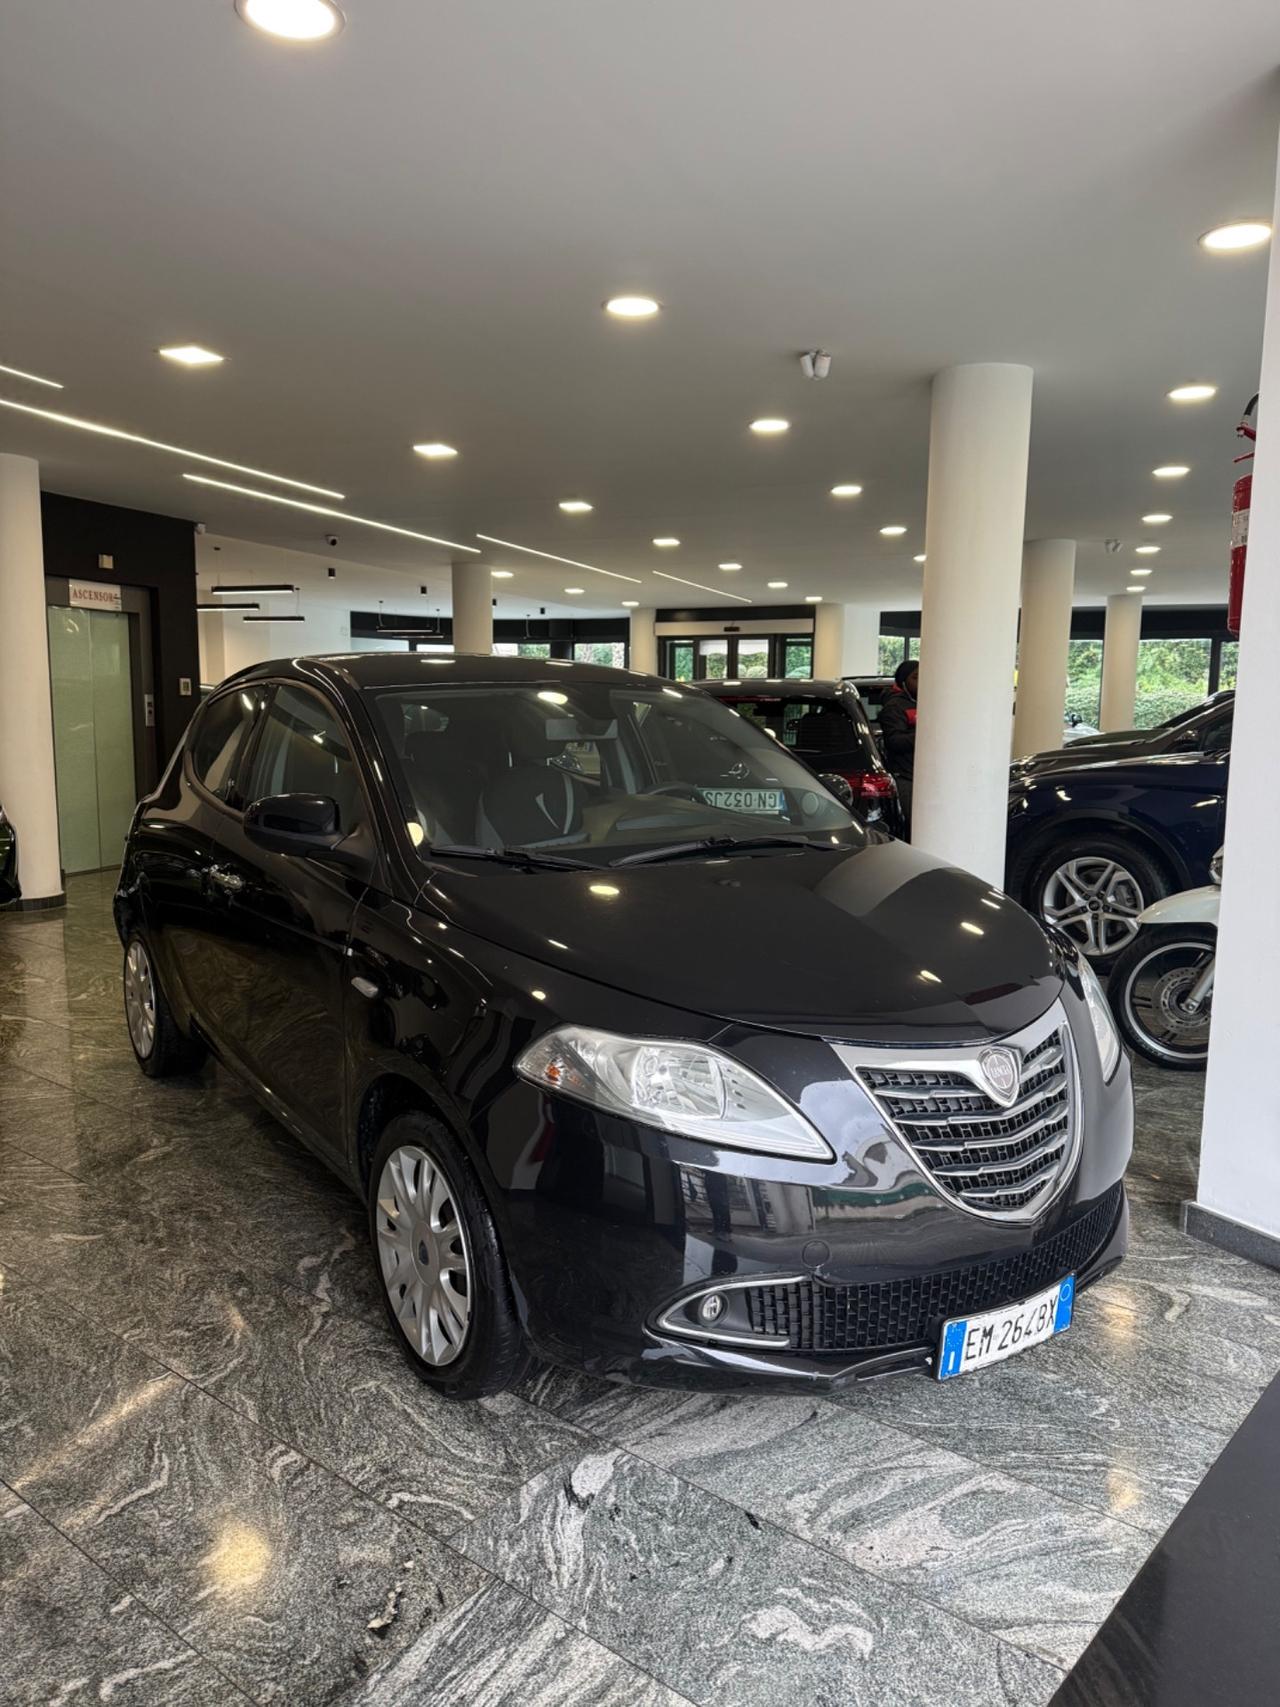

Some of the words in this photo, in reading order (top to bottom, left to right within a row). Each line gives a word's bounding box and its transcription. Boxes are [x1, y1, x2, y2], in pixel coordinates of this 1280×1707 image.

[73, 589, 118, 602] ASCENSOR
[705, 792, 752, 808] 032JS
[758, 792, 777, 808] GN
[965, 1324, 994, 1360] EM
[998, 1295, 1058, 1351] 264BX
